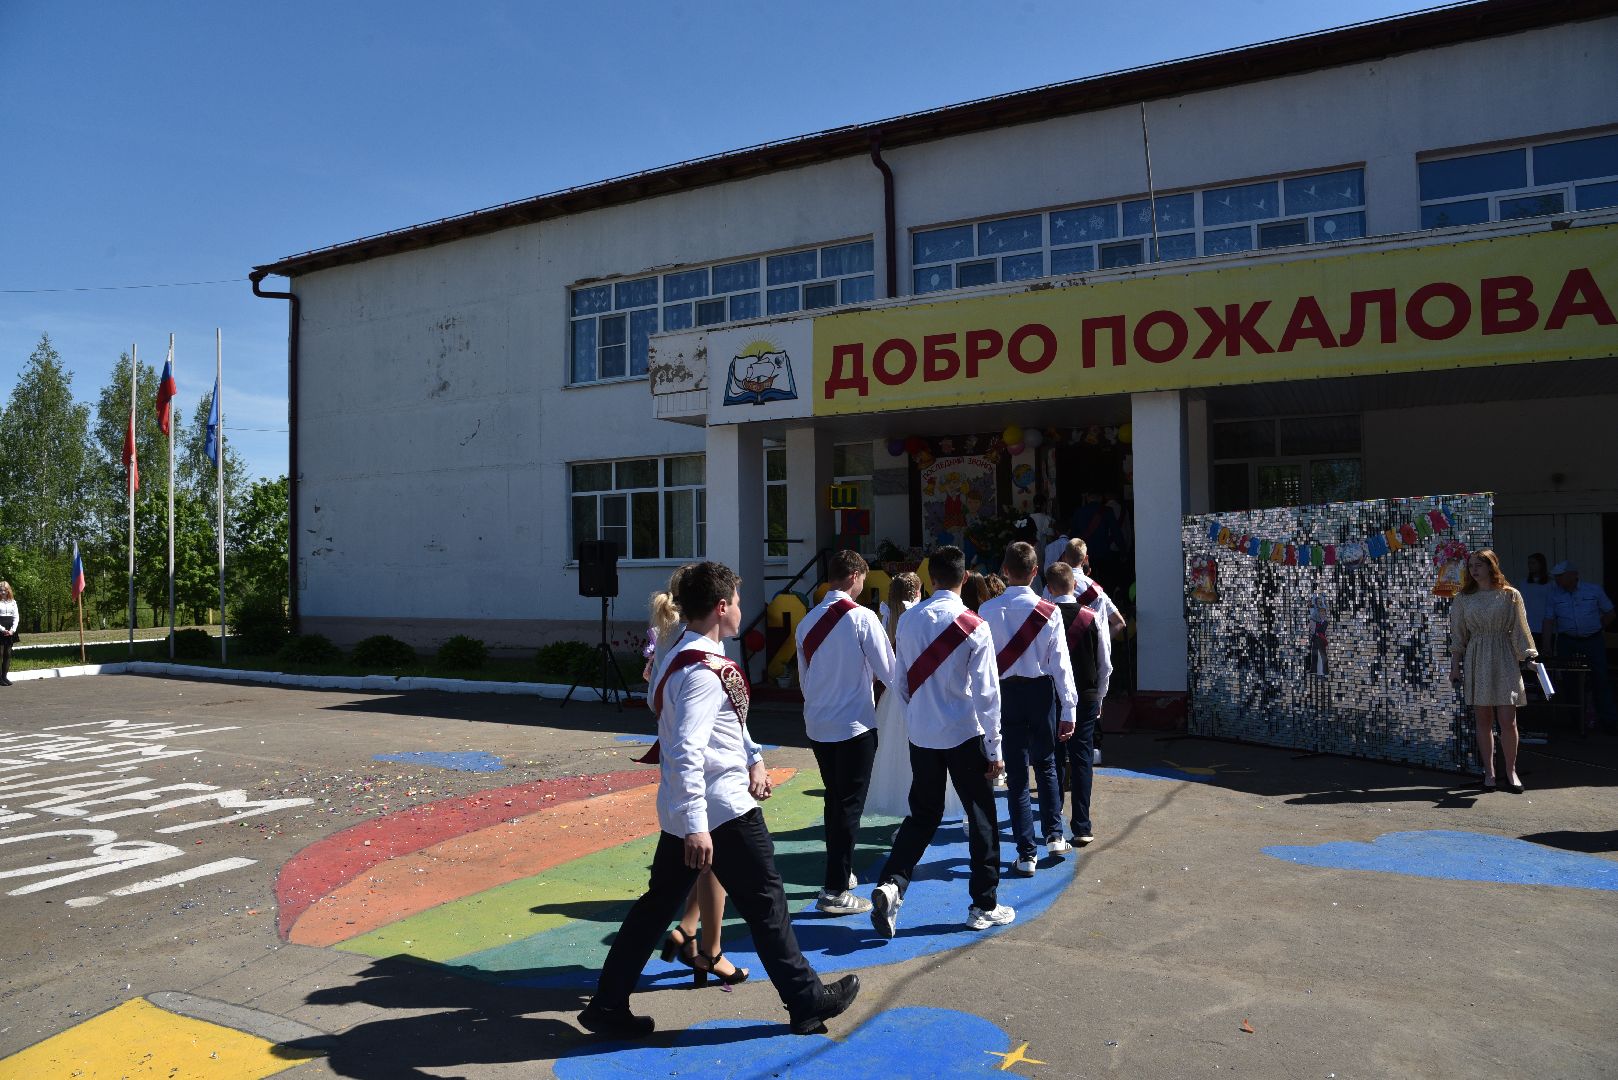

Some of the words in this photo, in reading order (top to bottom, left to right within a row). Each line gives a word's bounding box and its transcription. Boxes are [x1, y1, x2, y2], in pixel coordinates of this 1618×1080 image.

[824, 323, 1058, 400] ДОБРО
[1082, 267, 1618, 369] ПОЖАЛОВА
[43, 719, 242, 740] МЫ
